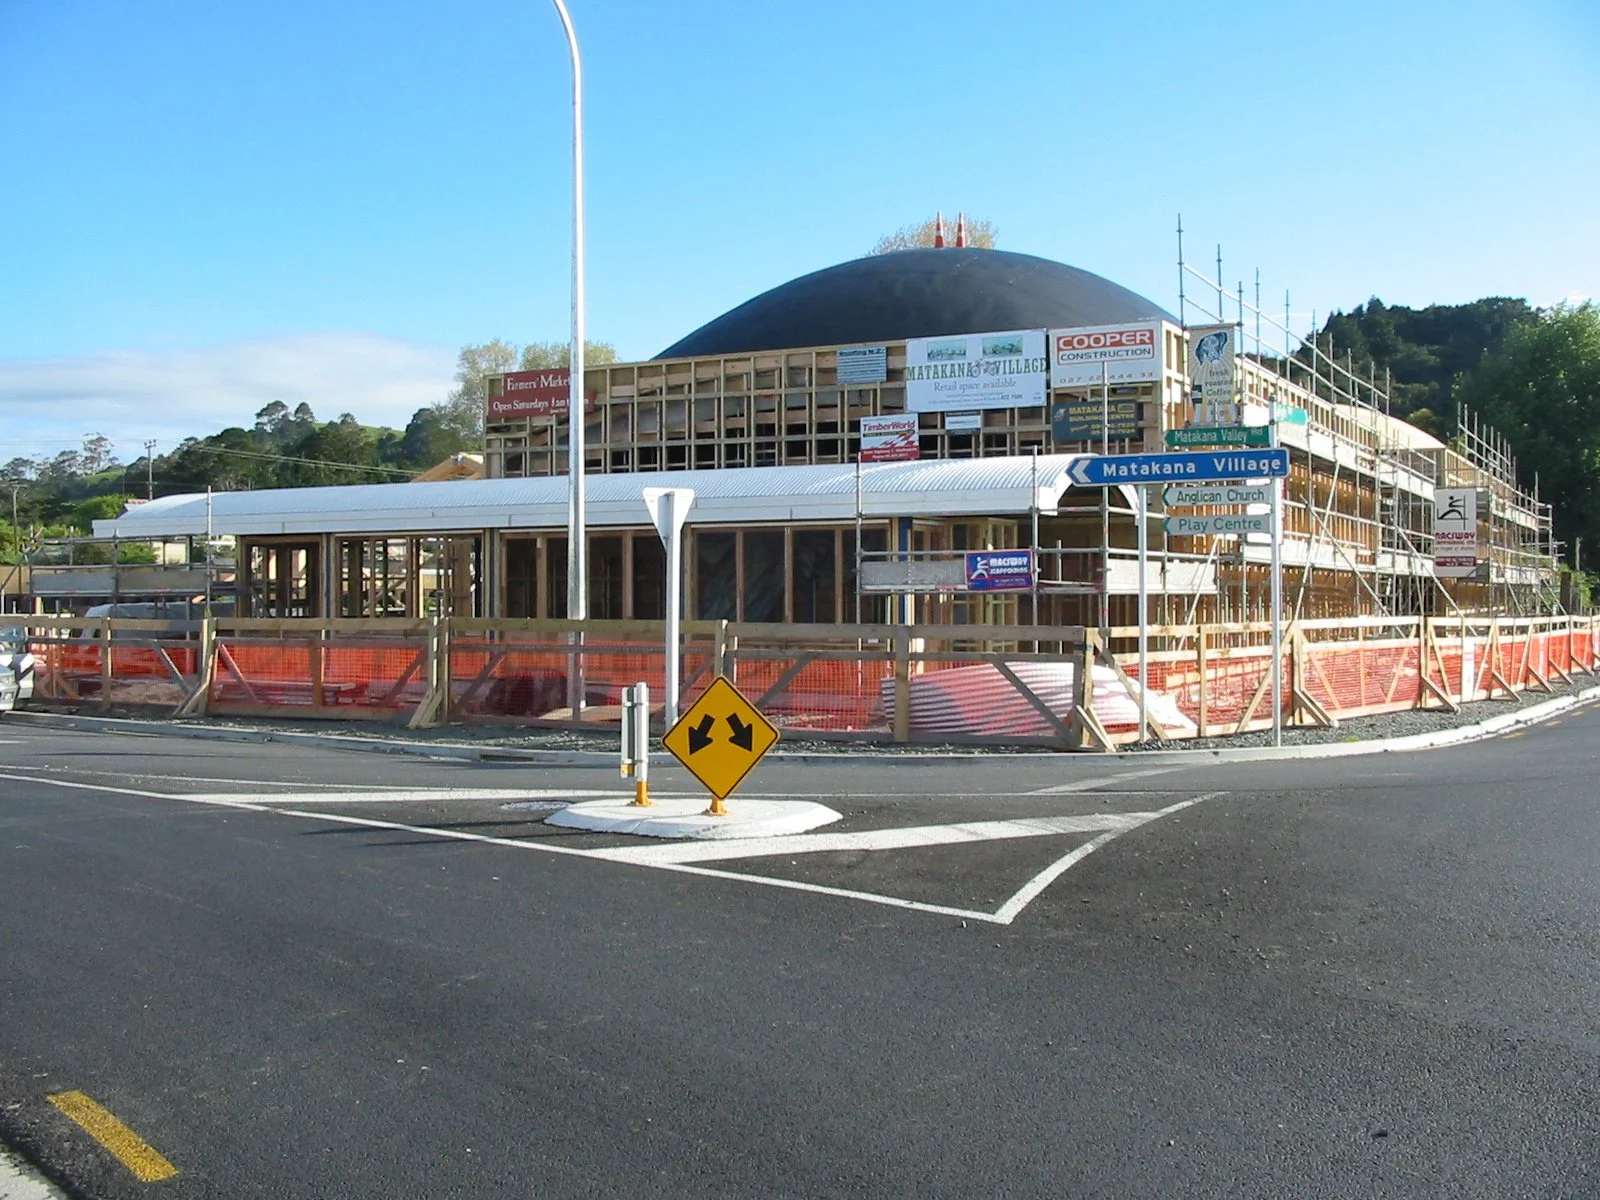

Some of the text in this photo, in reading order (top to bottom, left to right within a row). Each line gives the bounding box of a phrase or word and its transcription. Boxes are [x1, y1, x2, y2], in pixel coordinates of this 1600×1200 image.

[1058, 330, 1151, 349] COOPER
[1060, 348, 1151, 362] CONSTRUCTION
[906, 362, 974, 380] MATAKANA
[995, 357, 1047, 376] VILLAGE
[933, 378, 1017, 393] Retail space available
[493, 401, 512, 413] Open
[513, 398, 549, 412] Saturdays
[1069, 405, 1117, 414] MATAKAA
[1174, 430, 1218, 442] Matakana
[1221, 430, 1248, 443] Valley
[1102, 457, 1281, 477] Matakana Village
[1176, 488, 1265, 505] Anglican Church
[1178, 517, 1262, 532] Play Centre
